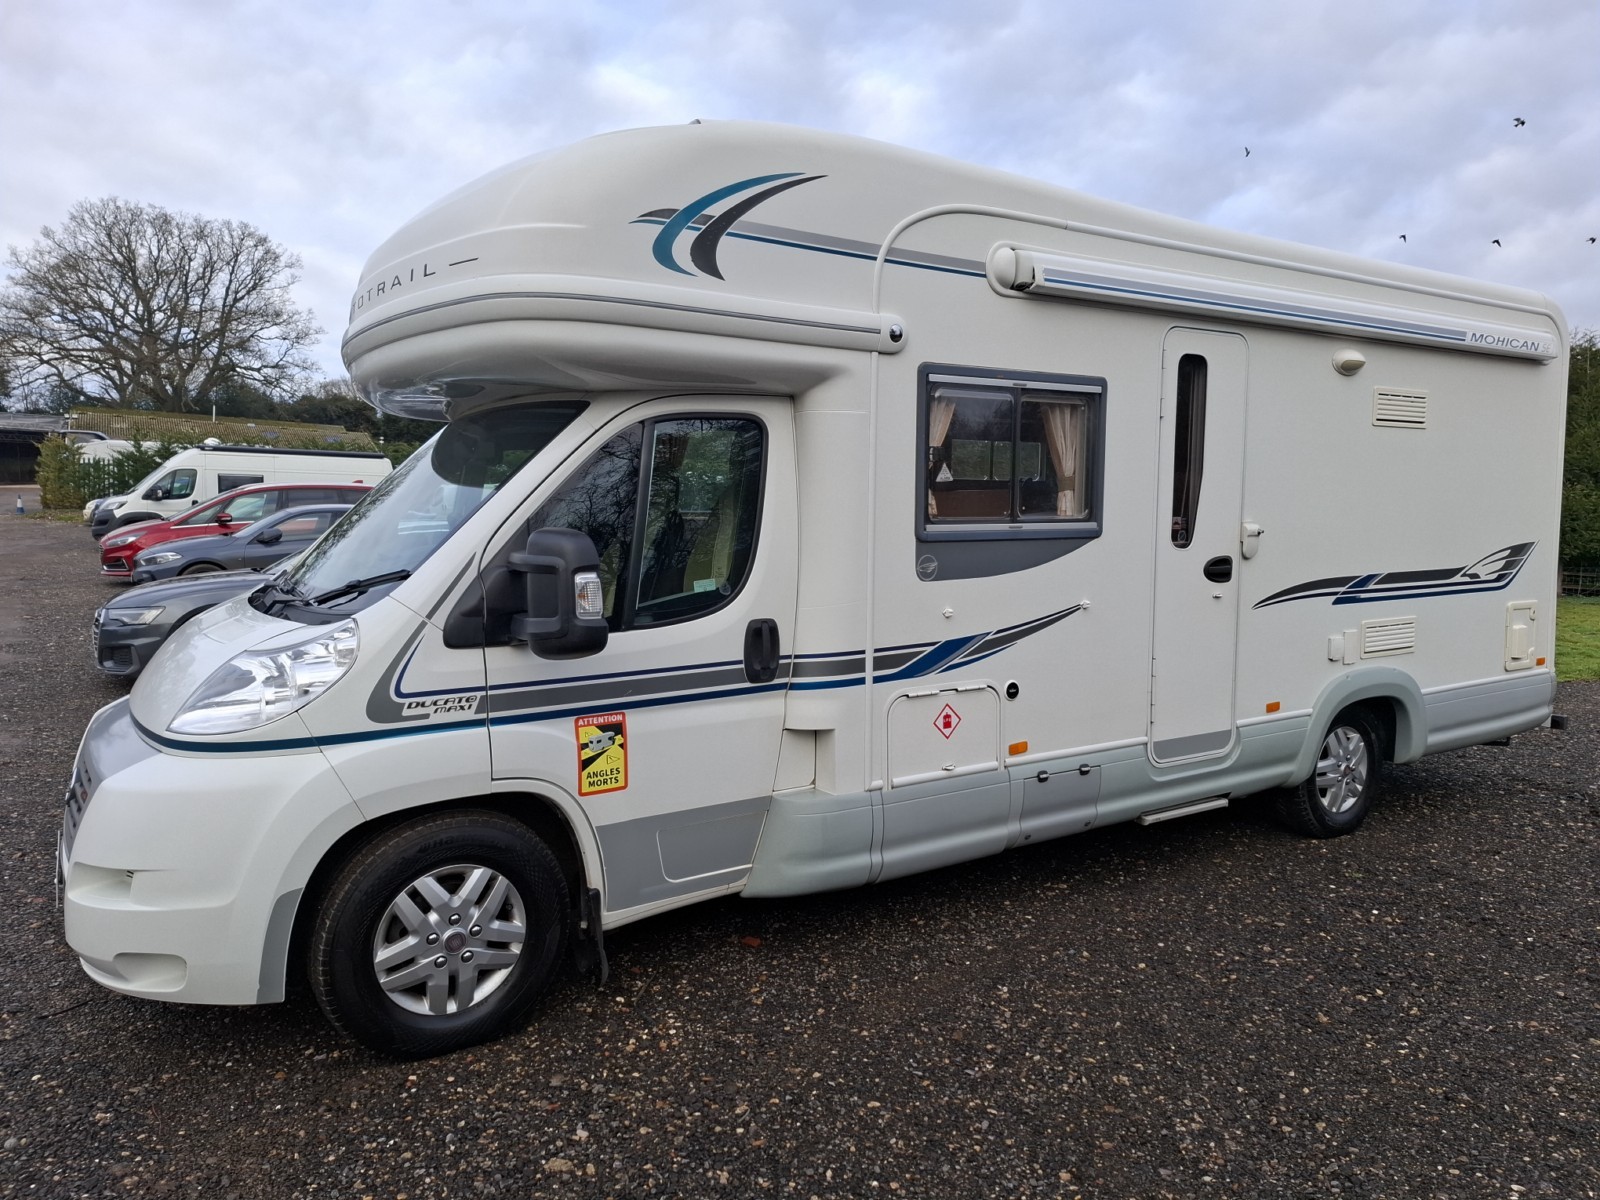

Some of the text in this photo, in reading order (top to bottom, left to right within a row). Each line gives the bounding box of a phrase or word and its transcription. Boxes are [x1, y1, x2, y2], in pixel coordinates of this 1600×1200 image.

[1470, 332, 1540, 352] MOHICAN
[406, 695, 478, 709] DUCATO
[433, 703, 473, 714] MAXI
[578, 714, 623, 726] ATTENTION
[586, 767, 621, 780] ANGLES
[588, 776, 619, 788] MORTS
